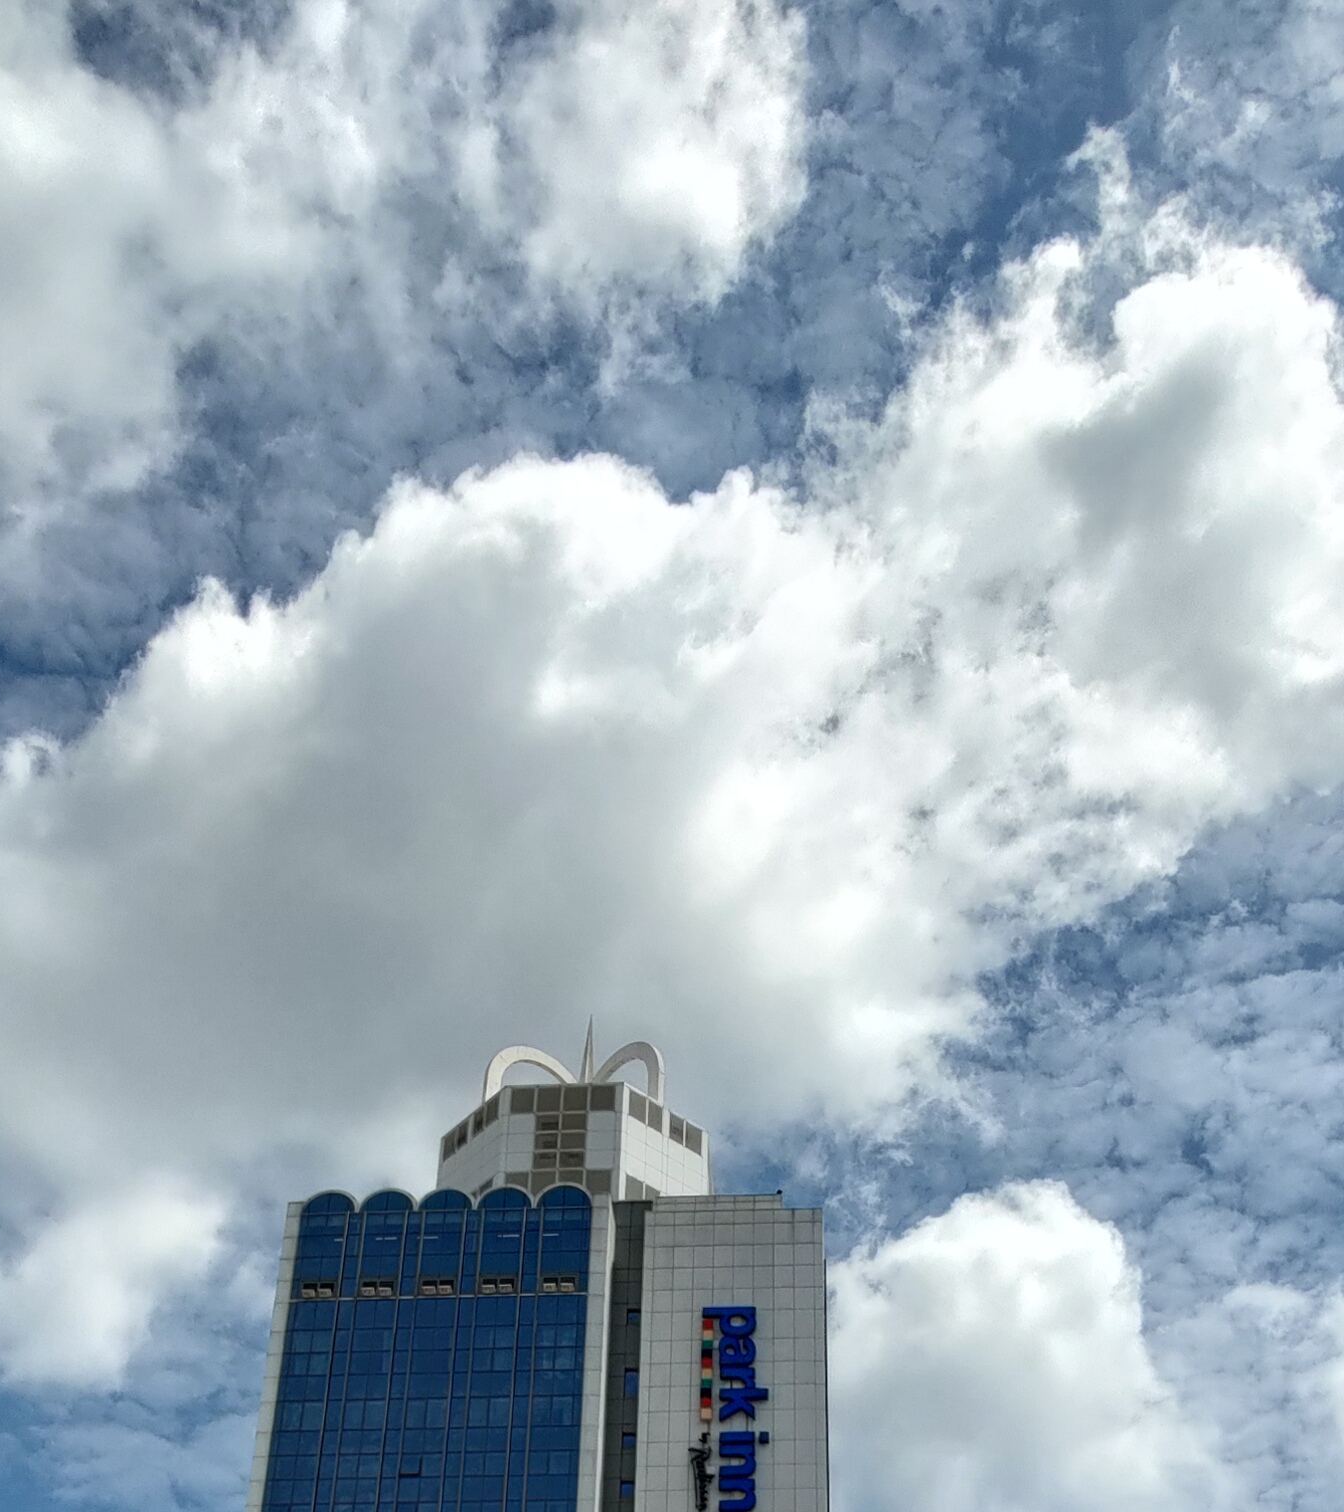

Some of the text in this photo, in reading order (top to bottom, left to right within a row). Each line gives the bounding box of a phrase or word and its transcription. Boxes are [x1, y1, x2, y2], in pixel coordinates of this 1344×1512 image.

[699, 1432, 710, 1444] by
[702, 1306, 769, 1512] park inn
